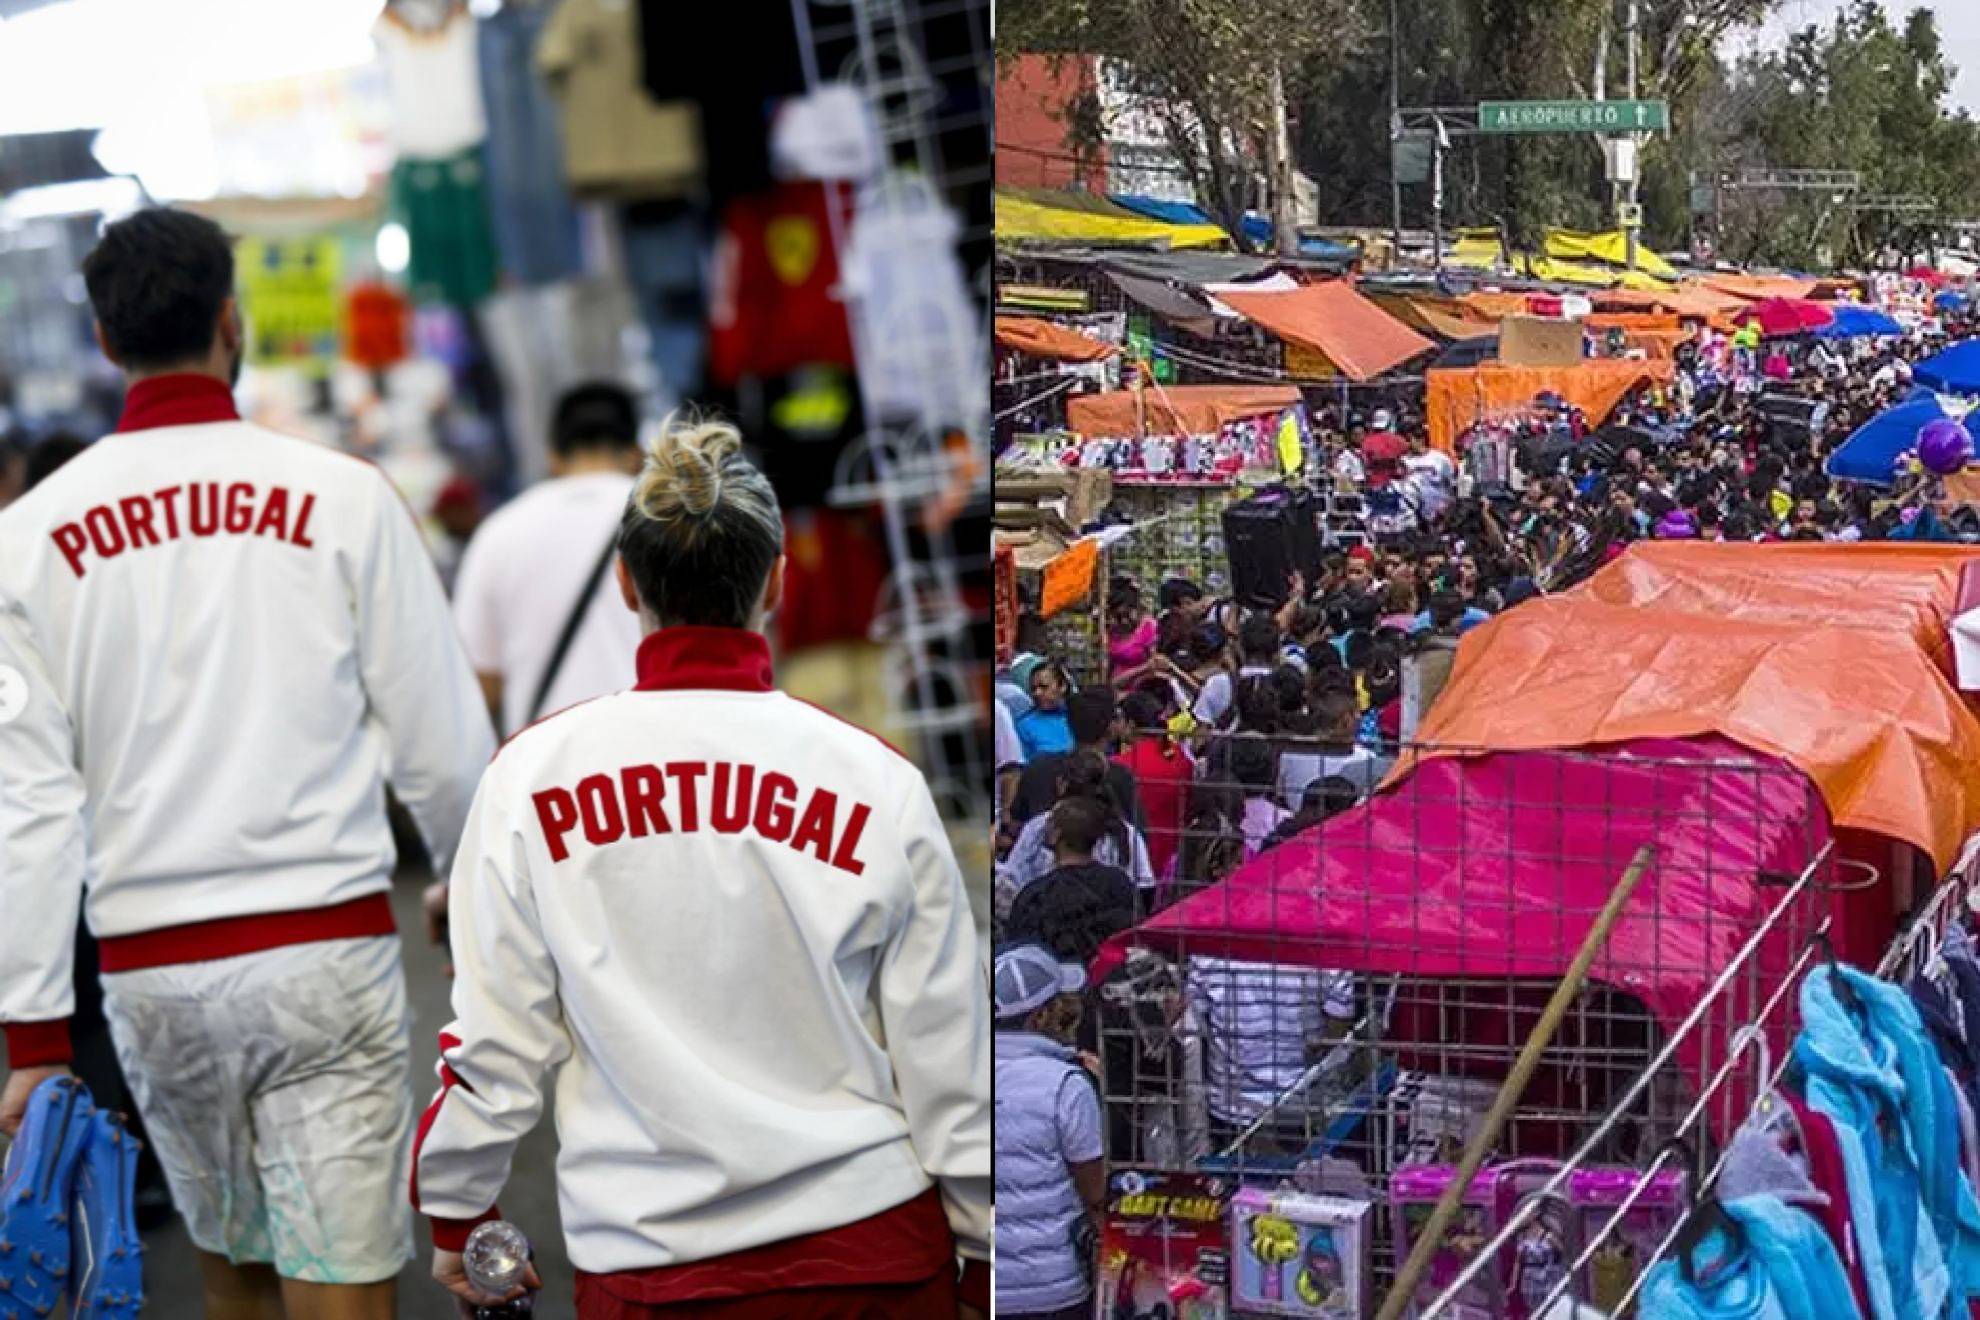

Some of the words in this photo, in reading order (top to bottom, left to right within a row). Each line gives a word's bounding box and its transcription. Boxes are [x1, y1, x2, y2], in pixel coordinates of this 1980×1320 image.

[1497, 106, 1618, 125] AEROPUERTO
[51, 481, 317, 580] PORTUGAL
[531, 761, 873, 877] PORTUGAL
